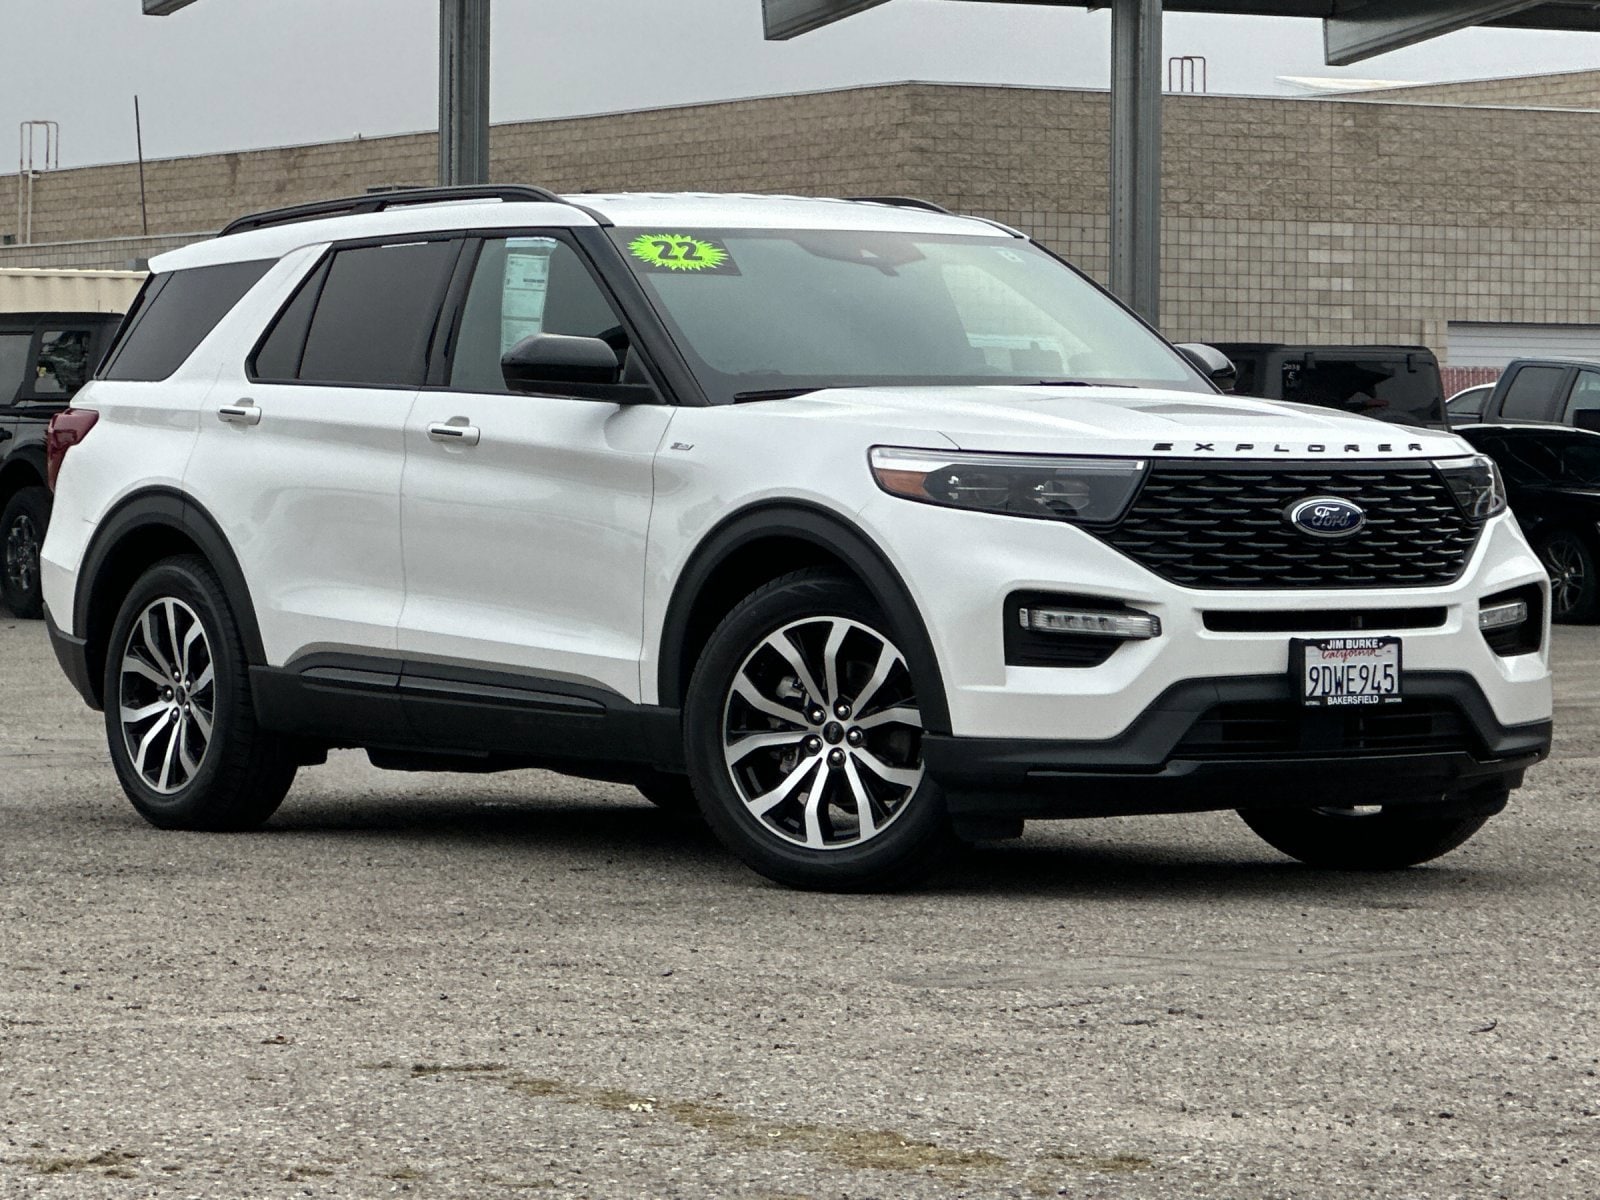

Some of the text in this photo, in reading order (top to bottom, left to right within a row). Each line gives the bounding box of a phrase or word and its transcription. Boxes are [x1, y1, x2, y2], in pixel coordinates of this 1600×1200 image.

[651, 241, 703, 261] 22
[1152, 443, 1423, 453] EXPLORER
[1311, 505, 1350, 527] Ford
[1327, 639, 1379, 650] JIM BURKE
[1321, 648, 1383, 663] California
[1308, 664, 1395, 697] 9DWE945
[1327, 695, 1379, 705] BAKERSFIELD
